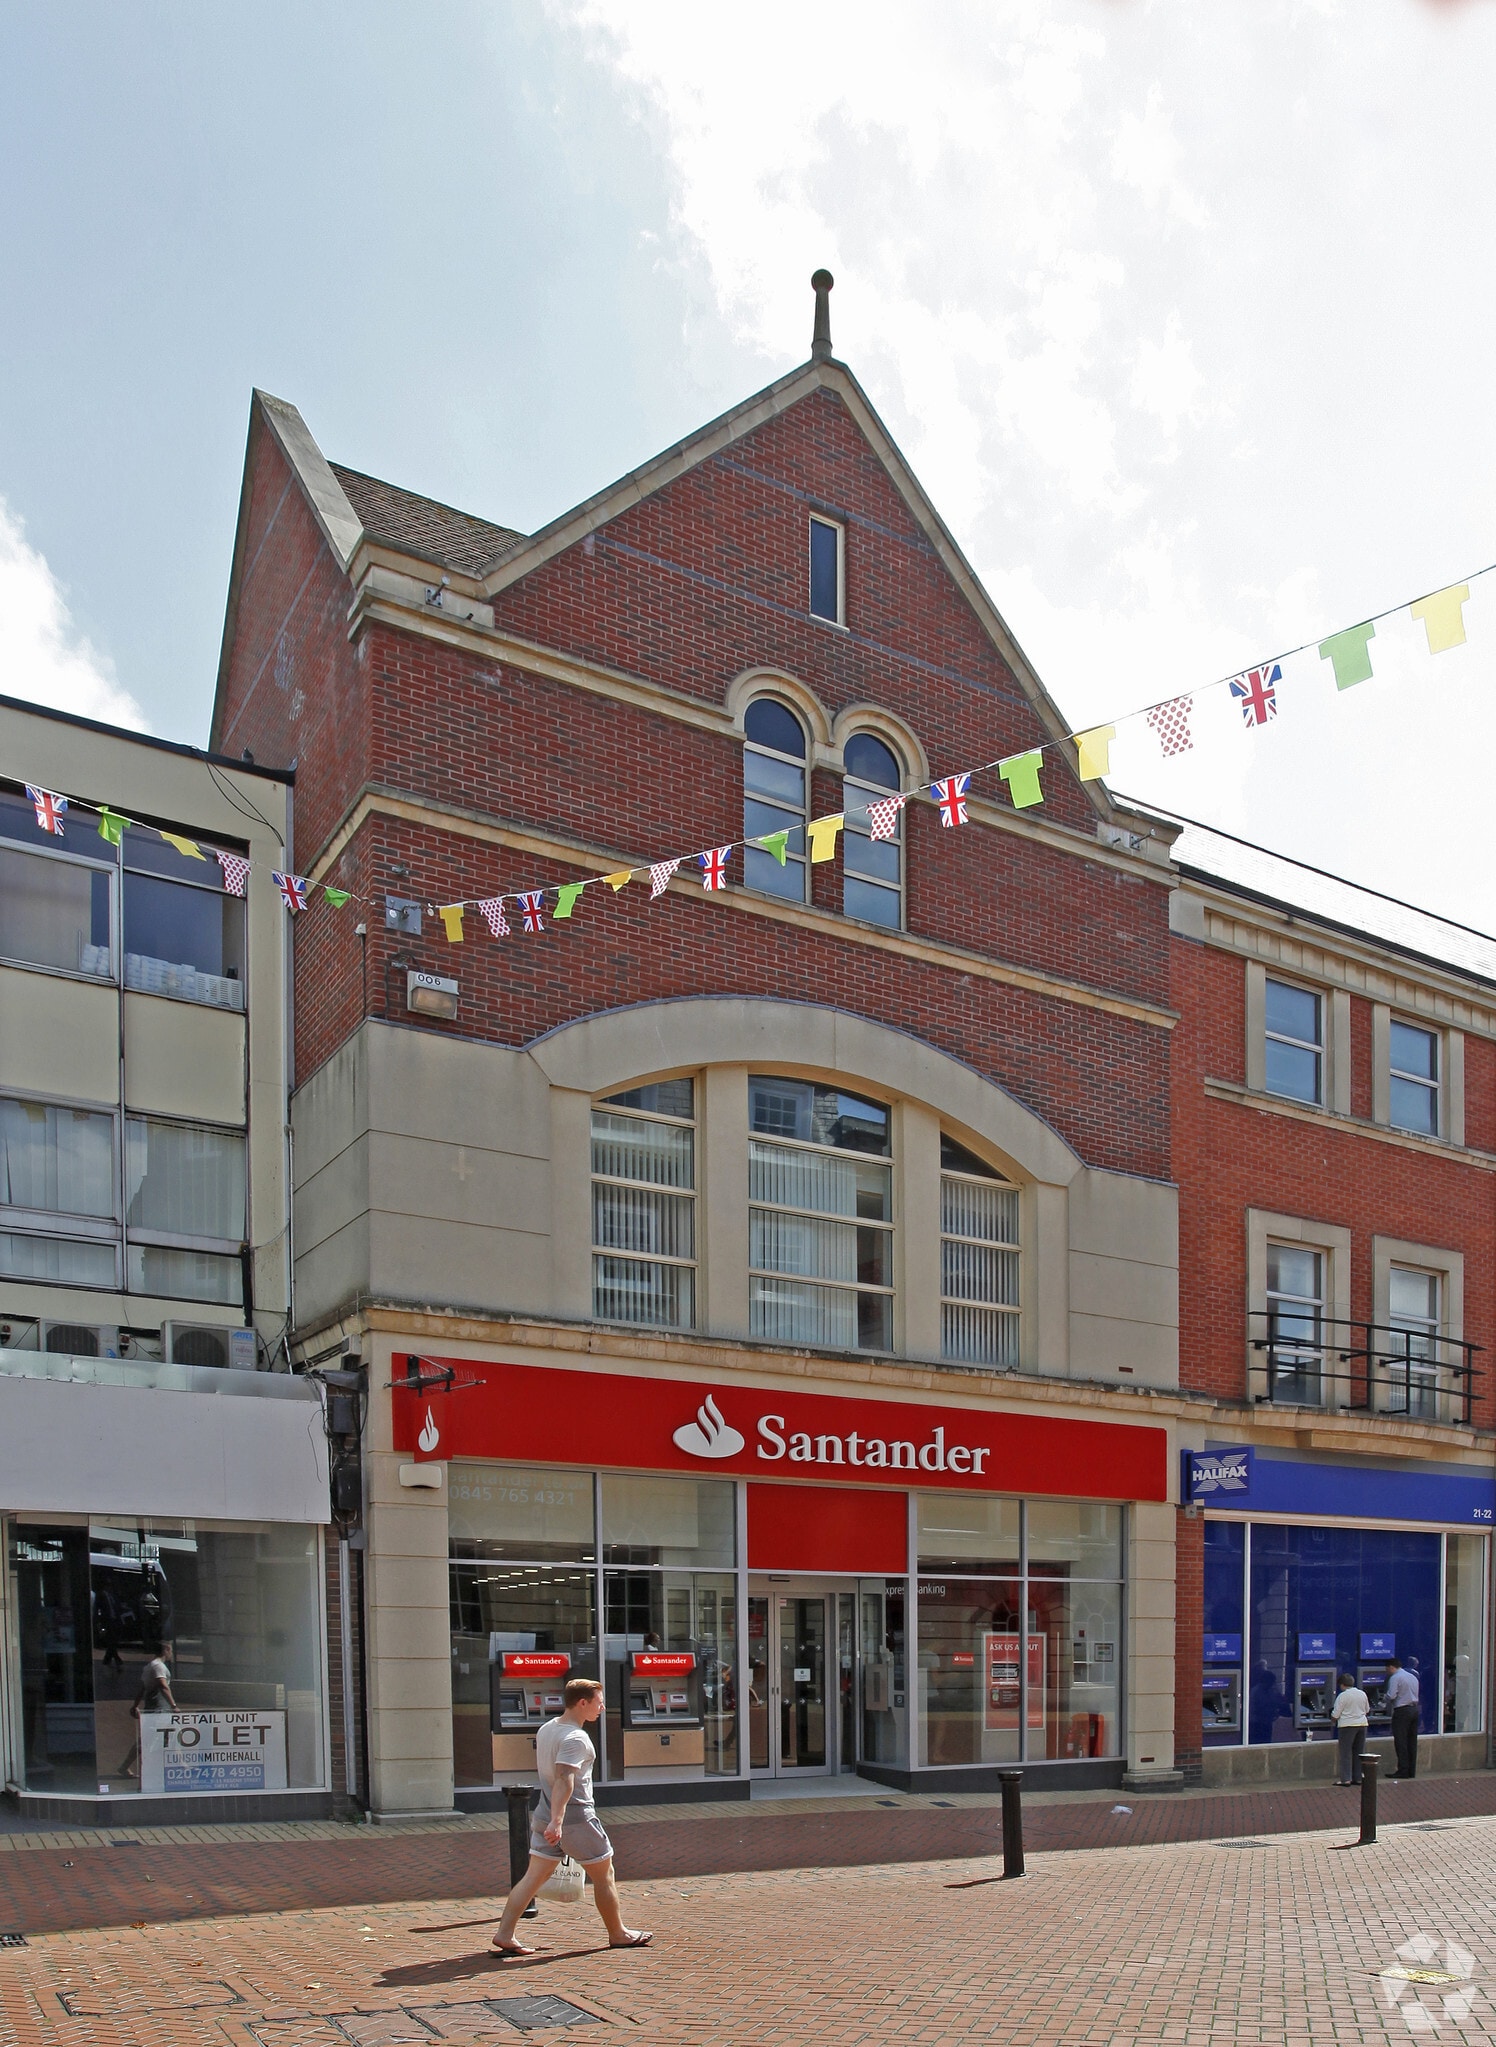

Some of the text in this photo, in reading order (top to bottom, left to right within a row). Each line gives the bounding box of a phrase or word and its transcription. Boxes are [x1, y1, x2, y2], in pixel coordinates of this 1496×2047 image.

[756, 1414, 990, 1475] Santander
[1192, 1465, 1248, 1481] HALIFAX
[449, 1485, 576, 1505] 0845 765 4321
[1473, 1508, 1492, 1519] 21-22
[917, 1584, 946, 1597] anking
[989, 1643, 1039, 1651] ASK US AUT
[524, 1653, 562, 1666] Santander
[652, 1653, 687, 1665] Santander
[171, 1713, 257, 1725] RETAIL UNIT
[156, 1725, 271, 1748] TO LET
[166, 1751, 261, 1764] LUNSONMITCHENALL
[167, 1766, 262, 1780] 020 7478 4950
